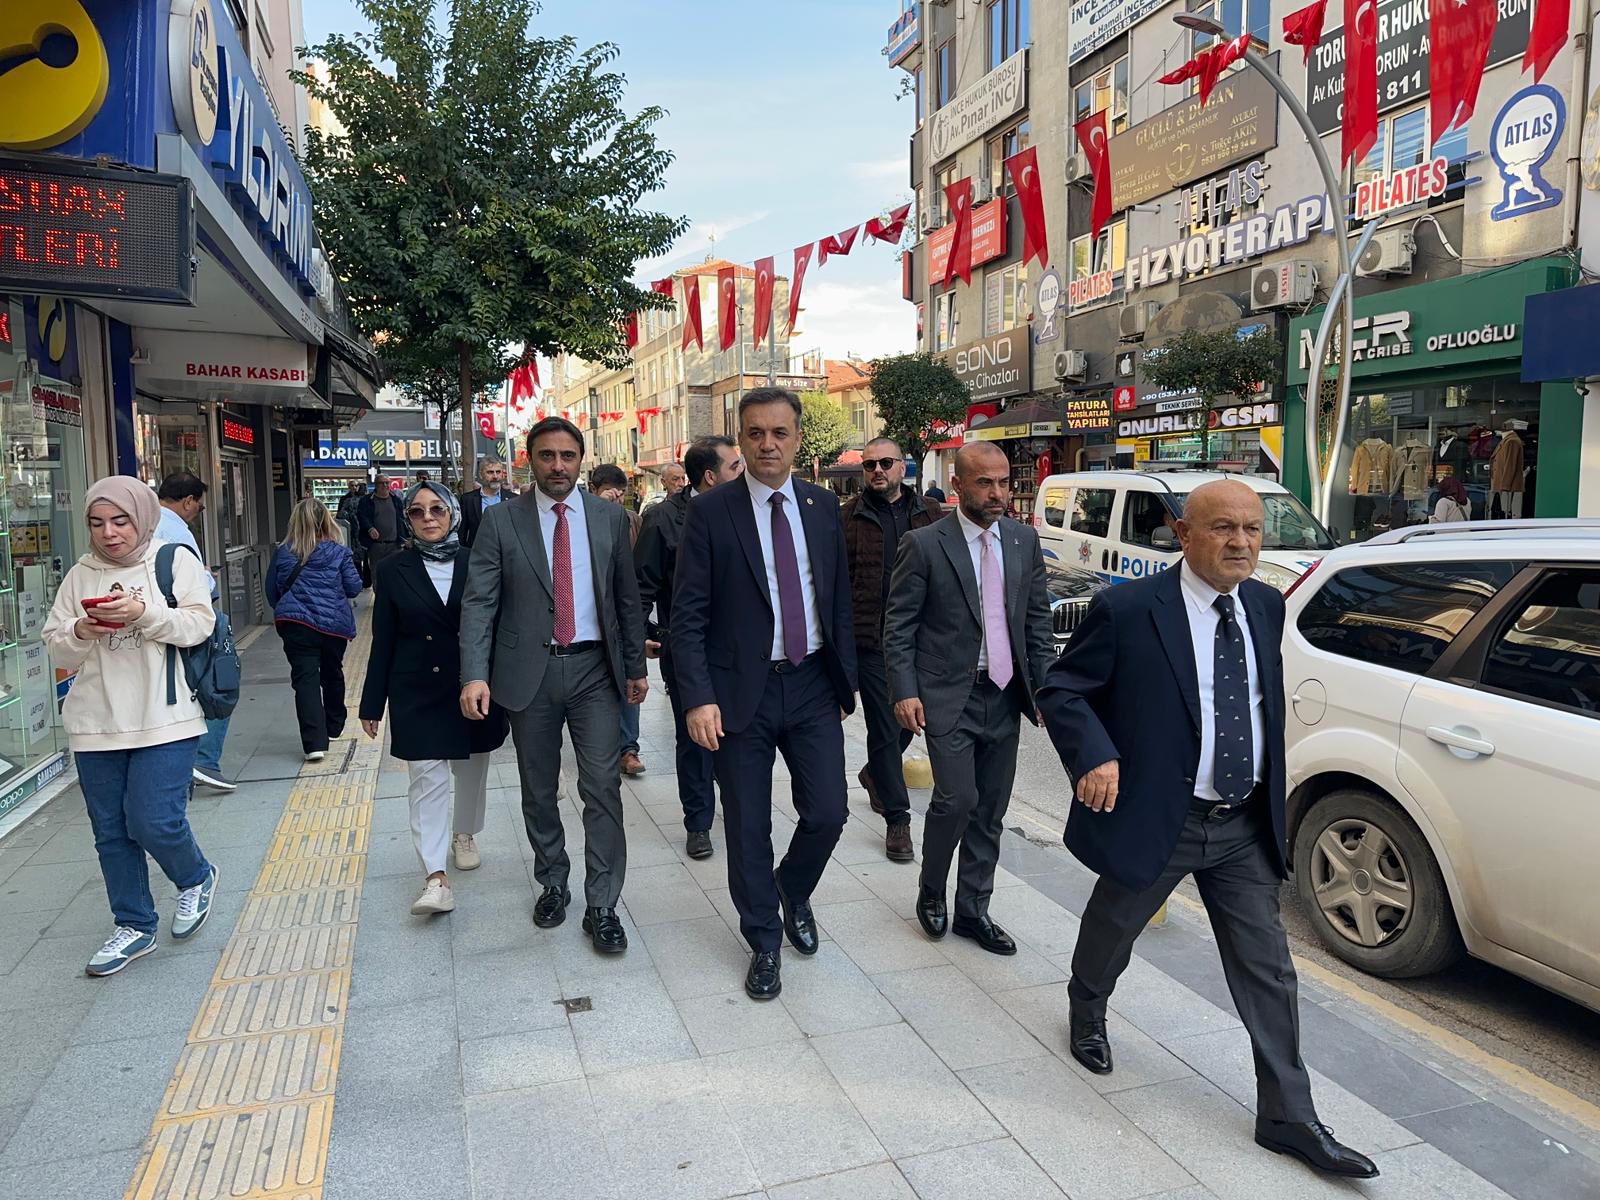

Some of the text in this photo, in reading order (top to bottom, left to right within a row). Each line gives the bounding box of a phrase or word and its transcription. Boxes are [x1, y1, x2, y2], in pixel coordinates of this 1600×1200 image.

[1072, 31, 1096, 53] Ahmet
[1097, 12, 1122, 36] Hamdi
[964, 84, 988, 109] HUKUK
[988, 61, 1017, 93] BÜROSU
[1312, 84, 1326, 105] Av.
[1376, 42, 1410, 77] ORUN
[1386, 70, 1421, 101] 811
[950, 124, 961, 141] Av.
[961, 102, 989, 133] Pınar
[1176, 110, 1185, 128] &
[1231, 106, 1259, 126] AVUKAT
[1503, 112, 1553, 149] ATLAS
[1178, 160, 1263, 229] ATLAS
[1356, 157, 1448, 219] PİLATES
[1041, 285, 1058, 303] ATLAS
[1426, 323, 1516, 352] OFLUOĞLU
[955, 336, 1012, 375] SONO
[1366, 342, 1411, 360] CRISE
[186, 362, 306, 383] BAHAR KASABI
[975, 367, 1020, 390] Cihazları
[1066, 409, 1110, 419] TAHSİLATLARI
[1067, 400, 1108, 411] FATURA
[1221, 403, 1276, 427] GSM
[1068, 417, 1110, 429] YAPILIR
[1121, 556, 1168, 577] POLİS
[36, 758, 64, 787] SAMSUNG
